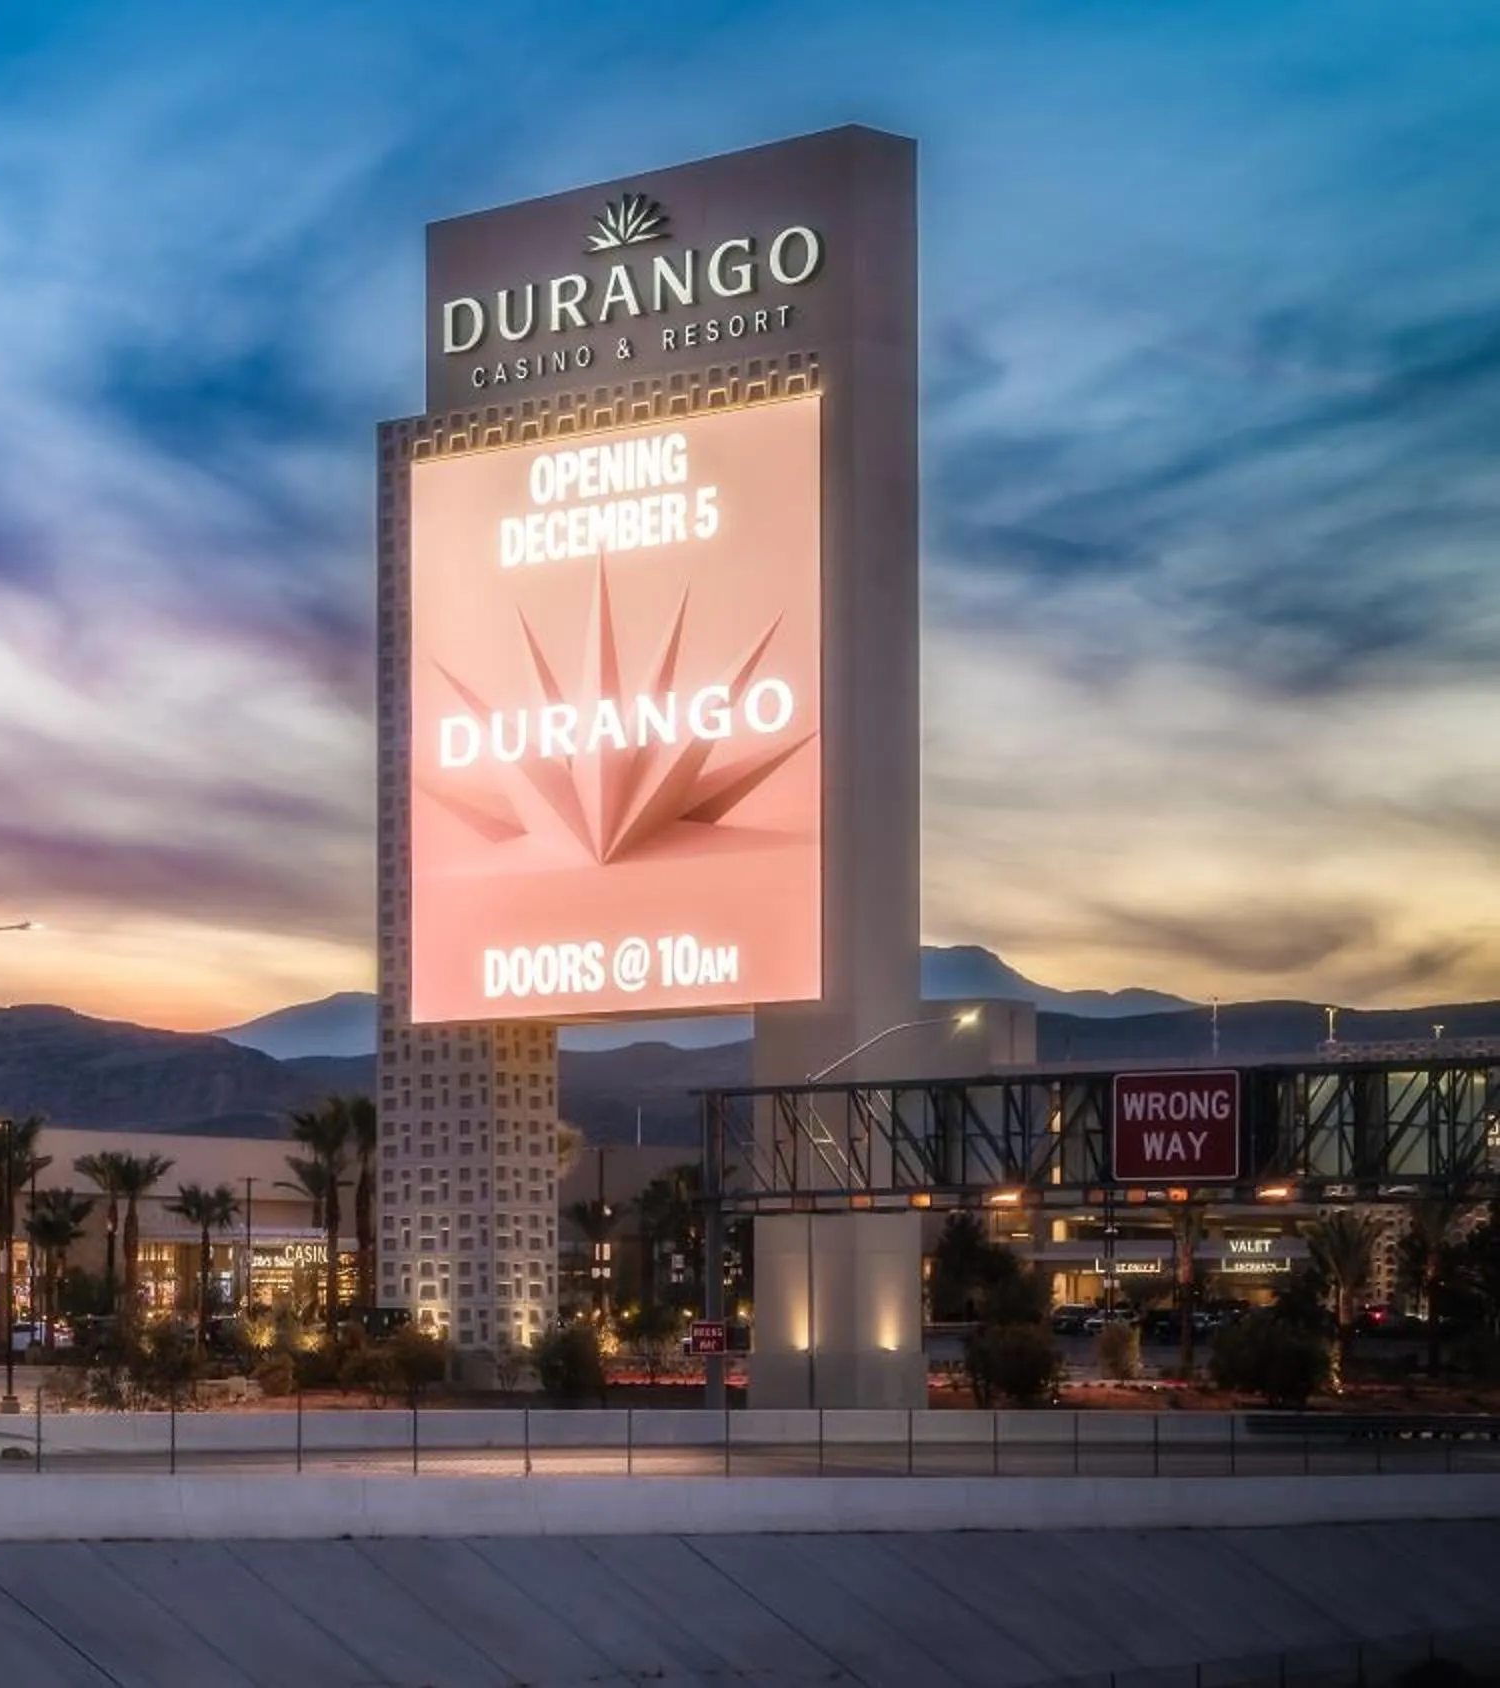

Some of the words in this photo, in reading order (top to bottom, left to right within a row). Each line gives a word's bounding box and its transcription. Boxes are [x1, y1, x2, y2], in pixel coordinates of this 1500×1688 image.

[443, 226, 821, 354] DURANGO
[472, 345, 593, 388] CASINO
[616, 337, 633, 360] &
[663, 305, 791, 351] RESORT
[529, 432, 688, 505] OPENING
[499, 492, 688, 568] DECEMBER
[693, 485, 719, 540] 5
[439, 677, 794, 769] DURANGO
[483, 941, 606, 998] DOORS
[612, 936, 651, 993] @
[1122, 1089, 1231, 1121] WRONG
[1142, 1130, 1209, 1161] WAY
[284, 1244, 329, 1264] CASIN
[1229, 1239, 1272, 1253] VALET
